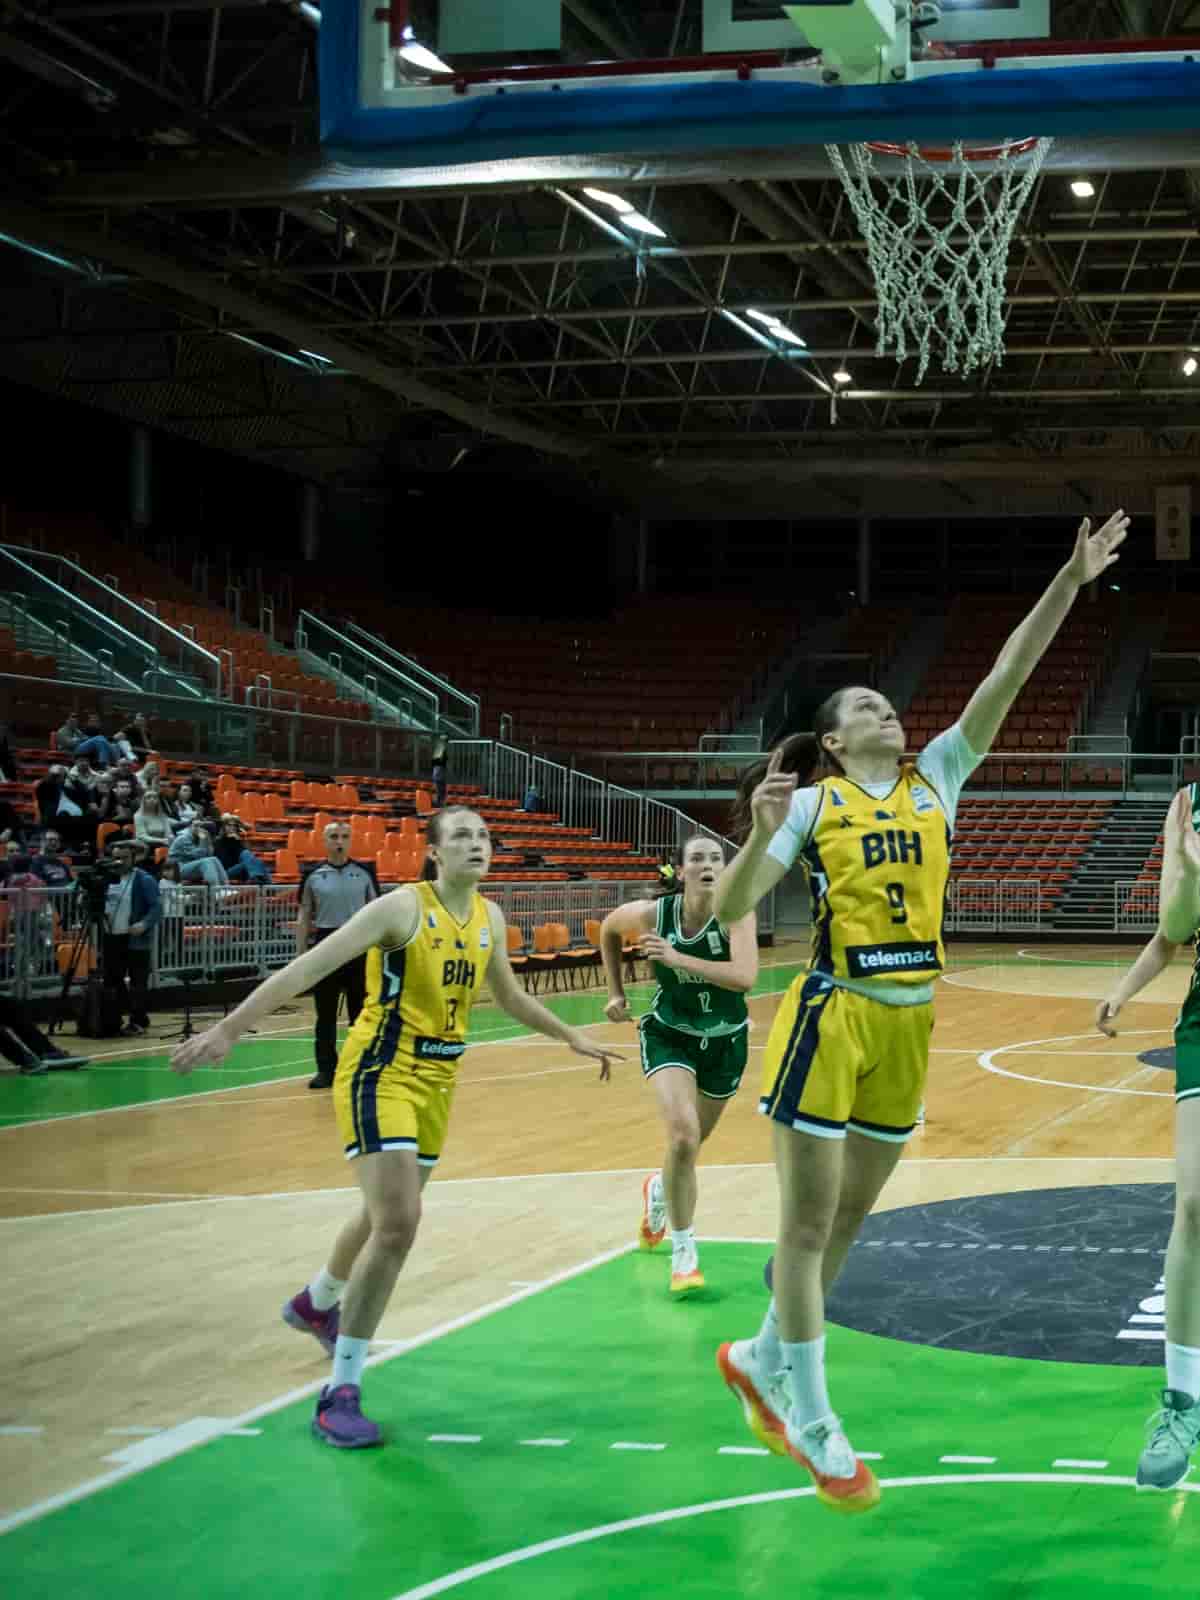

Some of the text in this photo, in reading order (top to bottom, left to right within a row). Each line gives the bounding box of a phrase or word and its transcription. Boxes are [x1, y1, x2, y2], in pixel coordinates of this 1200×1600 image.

[861, 829, 922, 869] BIH
[886, 881, 908, 924] 9
[442, 960, 476, 989] BIH
[697, 991, 713, 1014] 12
